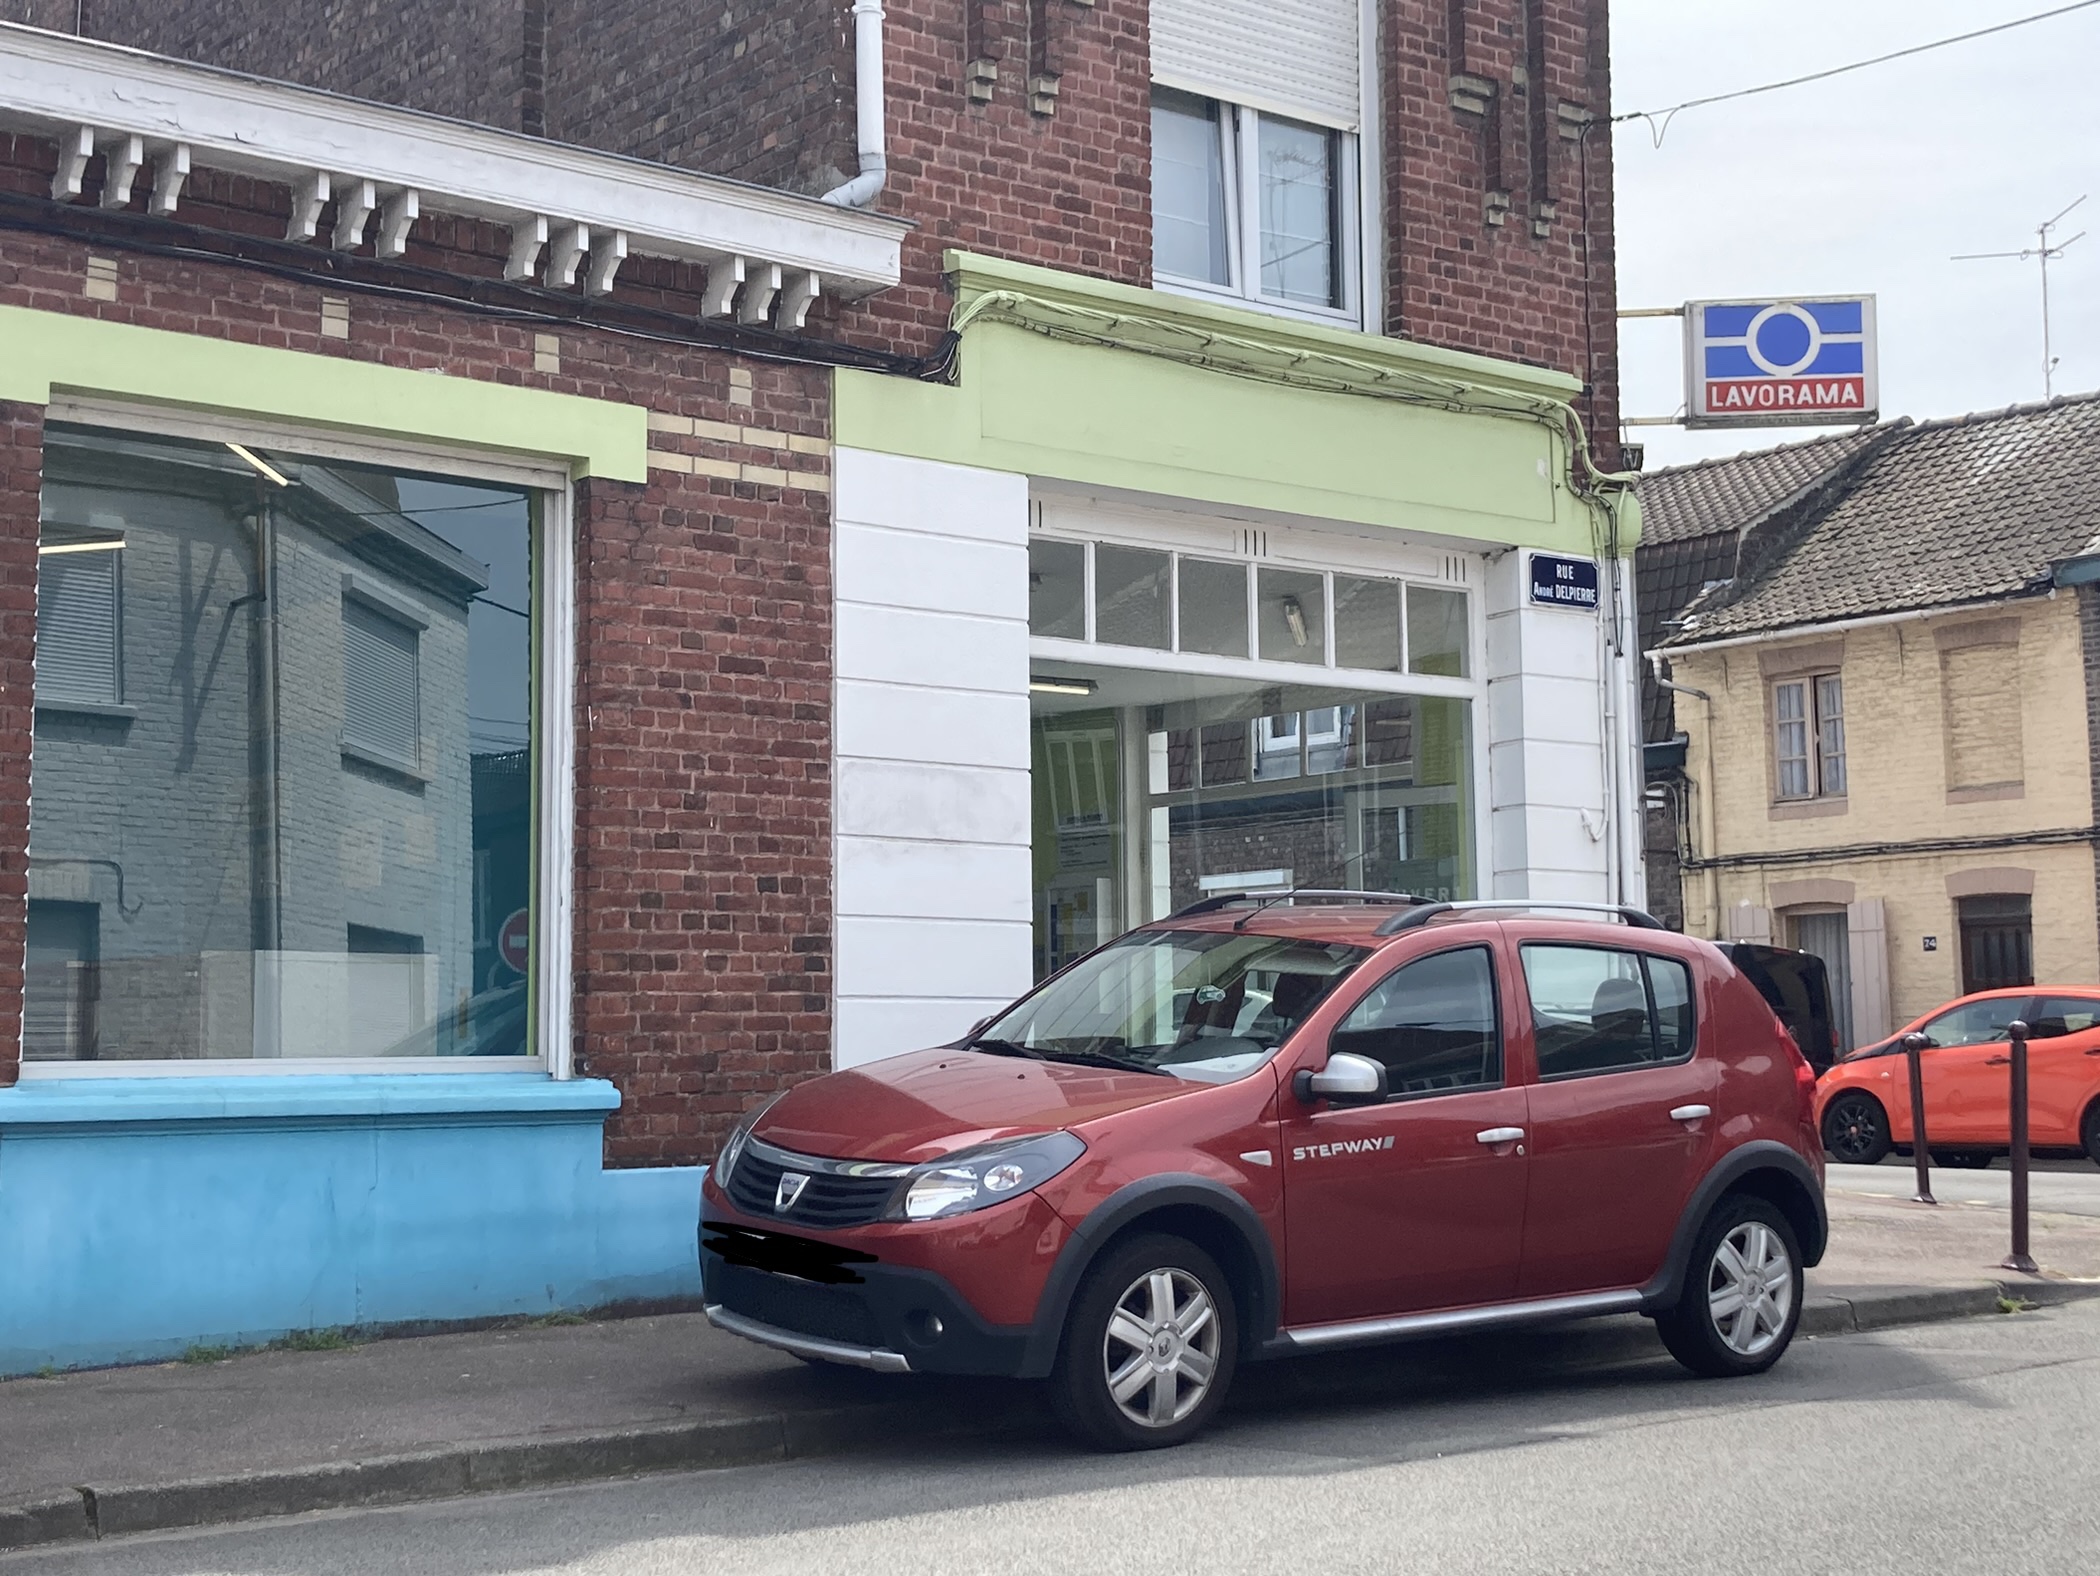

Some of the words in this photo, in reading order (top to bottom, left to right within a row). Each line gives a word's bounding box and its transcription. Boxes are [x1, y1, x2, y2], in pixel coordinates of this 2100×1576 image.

[1711, 382, 1858, 407] LAVORAMA
[1556, 564, 1574, 580] RUE
[1555, 584, 1597, 603] DELPIERRE
[1293, 1137, 1383, 1161] STEPWAY
